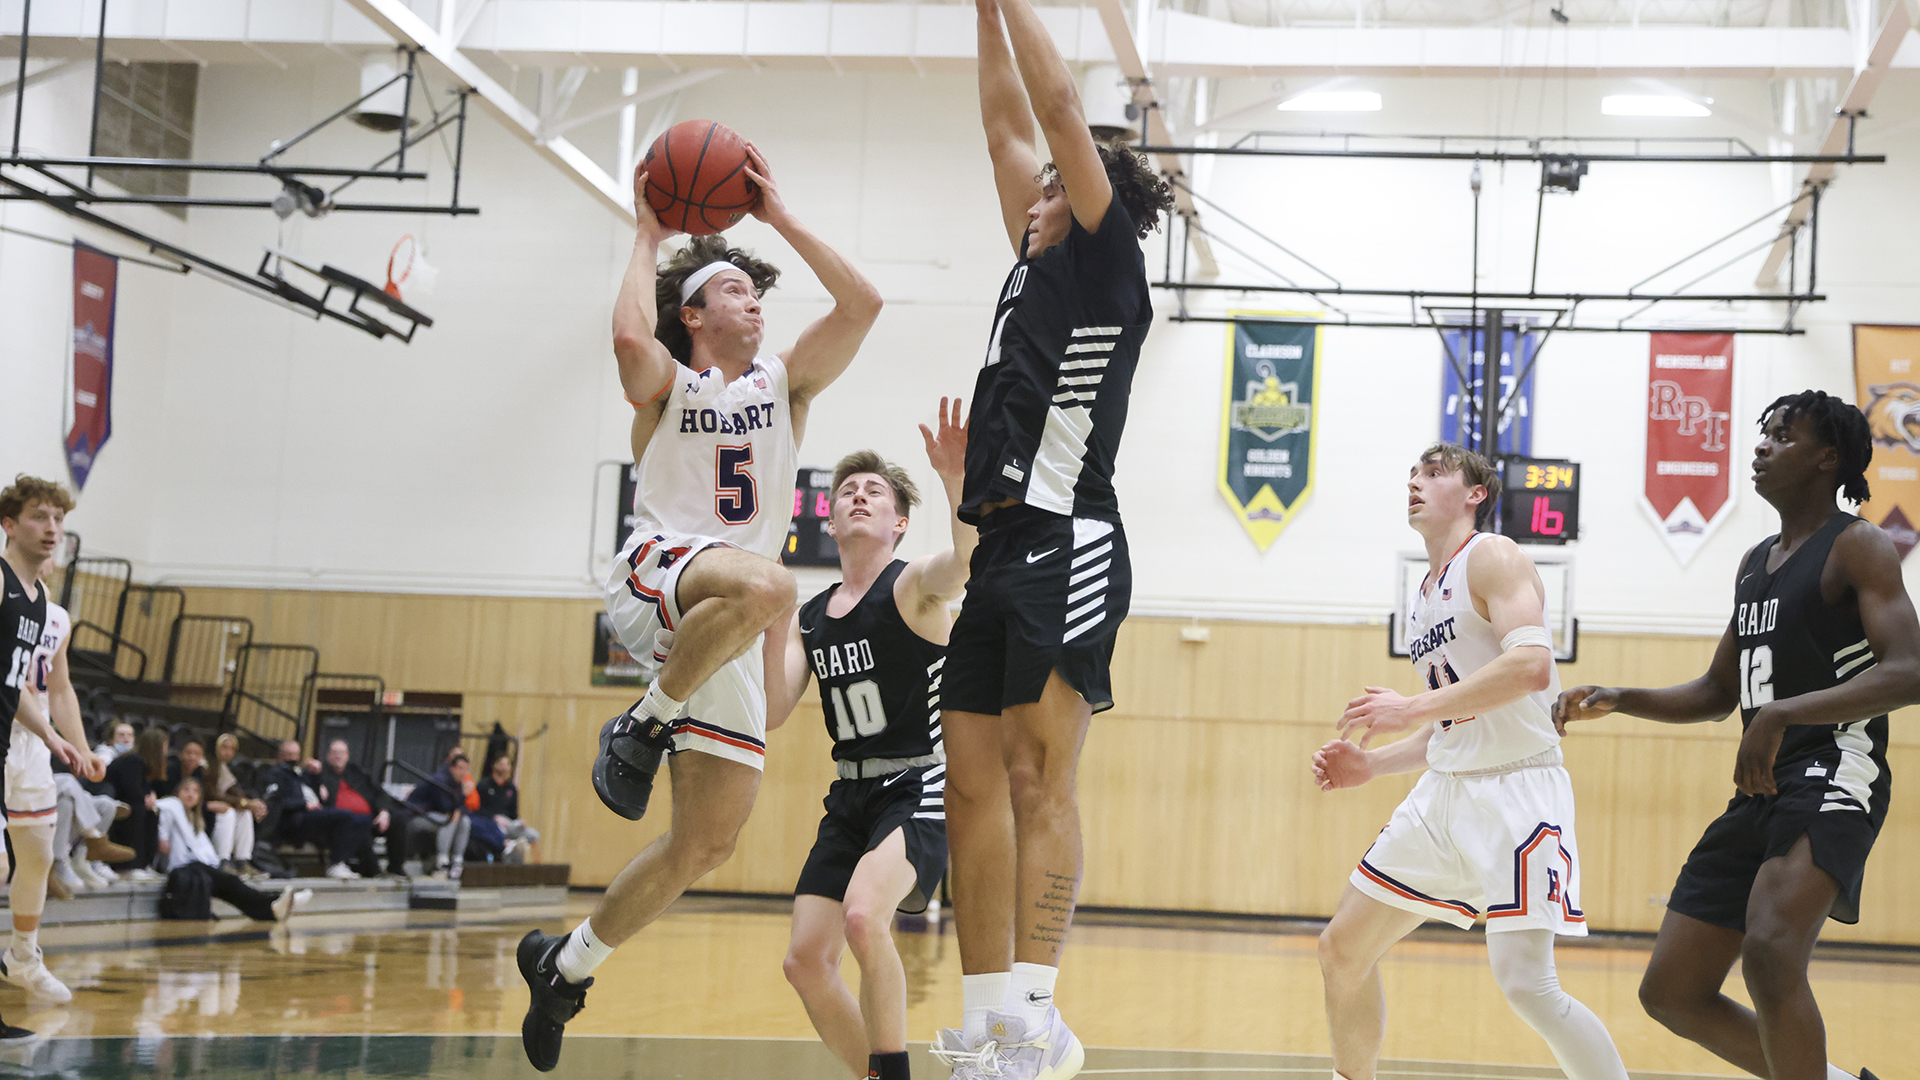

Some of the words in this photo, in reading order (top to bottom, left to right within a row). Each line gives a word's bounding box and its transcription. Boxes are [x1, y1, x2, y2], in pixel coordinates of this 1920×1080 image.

[1245, 344, 1303, 360] CLARKSON
[1655, 354, 1728, 370] RENSSELAER
[680, 402, 775, 435] HOBART
[1650, 380, 1729, 452] RPI
[1243, 463, 1292, 478] KNIGHTS
[1247, 449, 1290, 463] GOLDEN
[1656, 461, 1719, 476] ENGINEERS
[715, 442, 759, 525] 5
[1524, 465, 1573, 489] 3:34
[1531, 496, 1564, 535] 16
[17, 614, 40, 646] BARD
[1738, 598, 1779, 637] BARD
[812, 638, 875, 679] BARD
[1410, 616, 1456, 665] HOBART
[5, 646, 31, 690] 13
[1739, 645, 1775, 710] 12
[831, 679, 888, 741] 10
